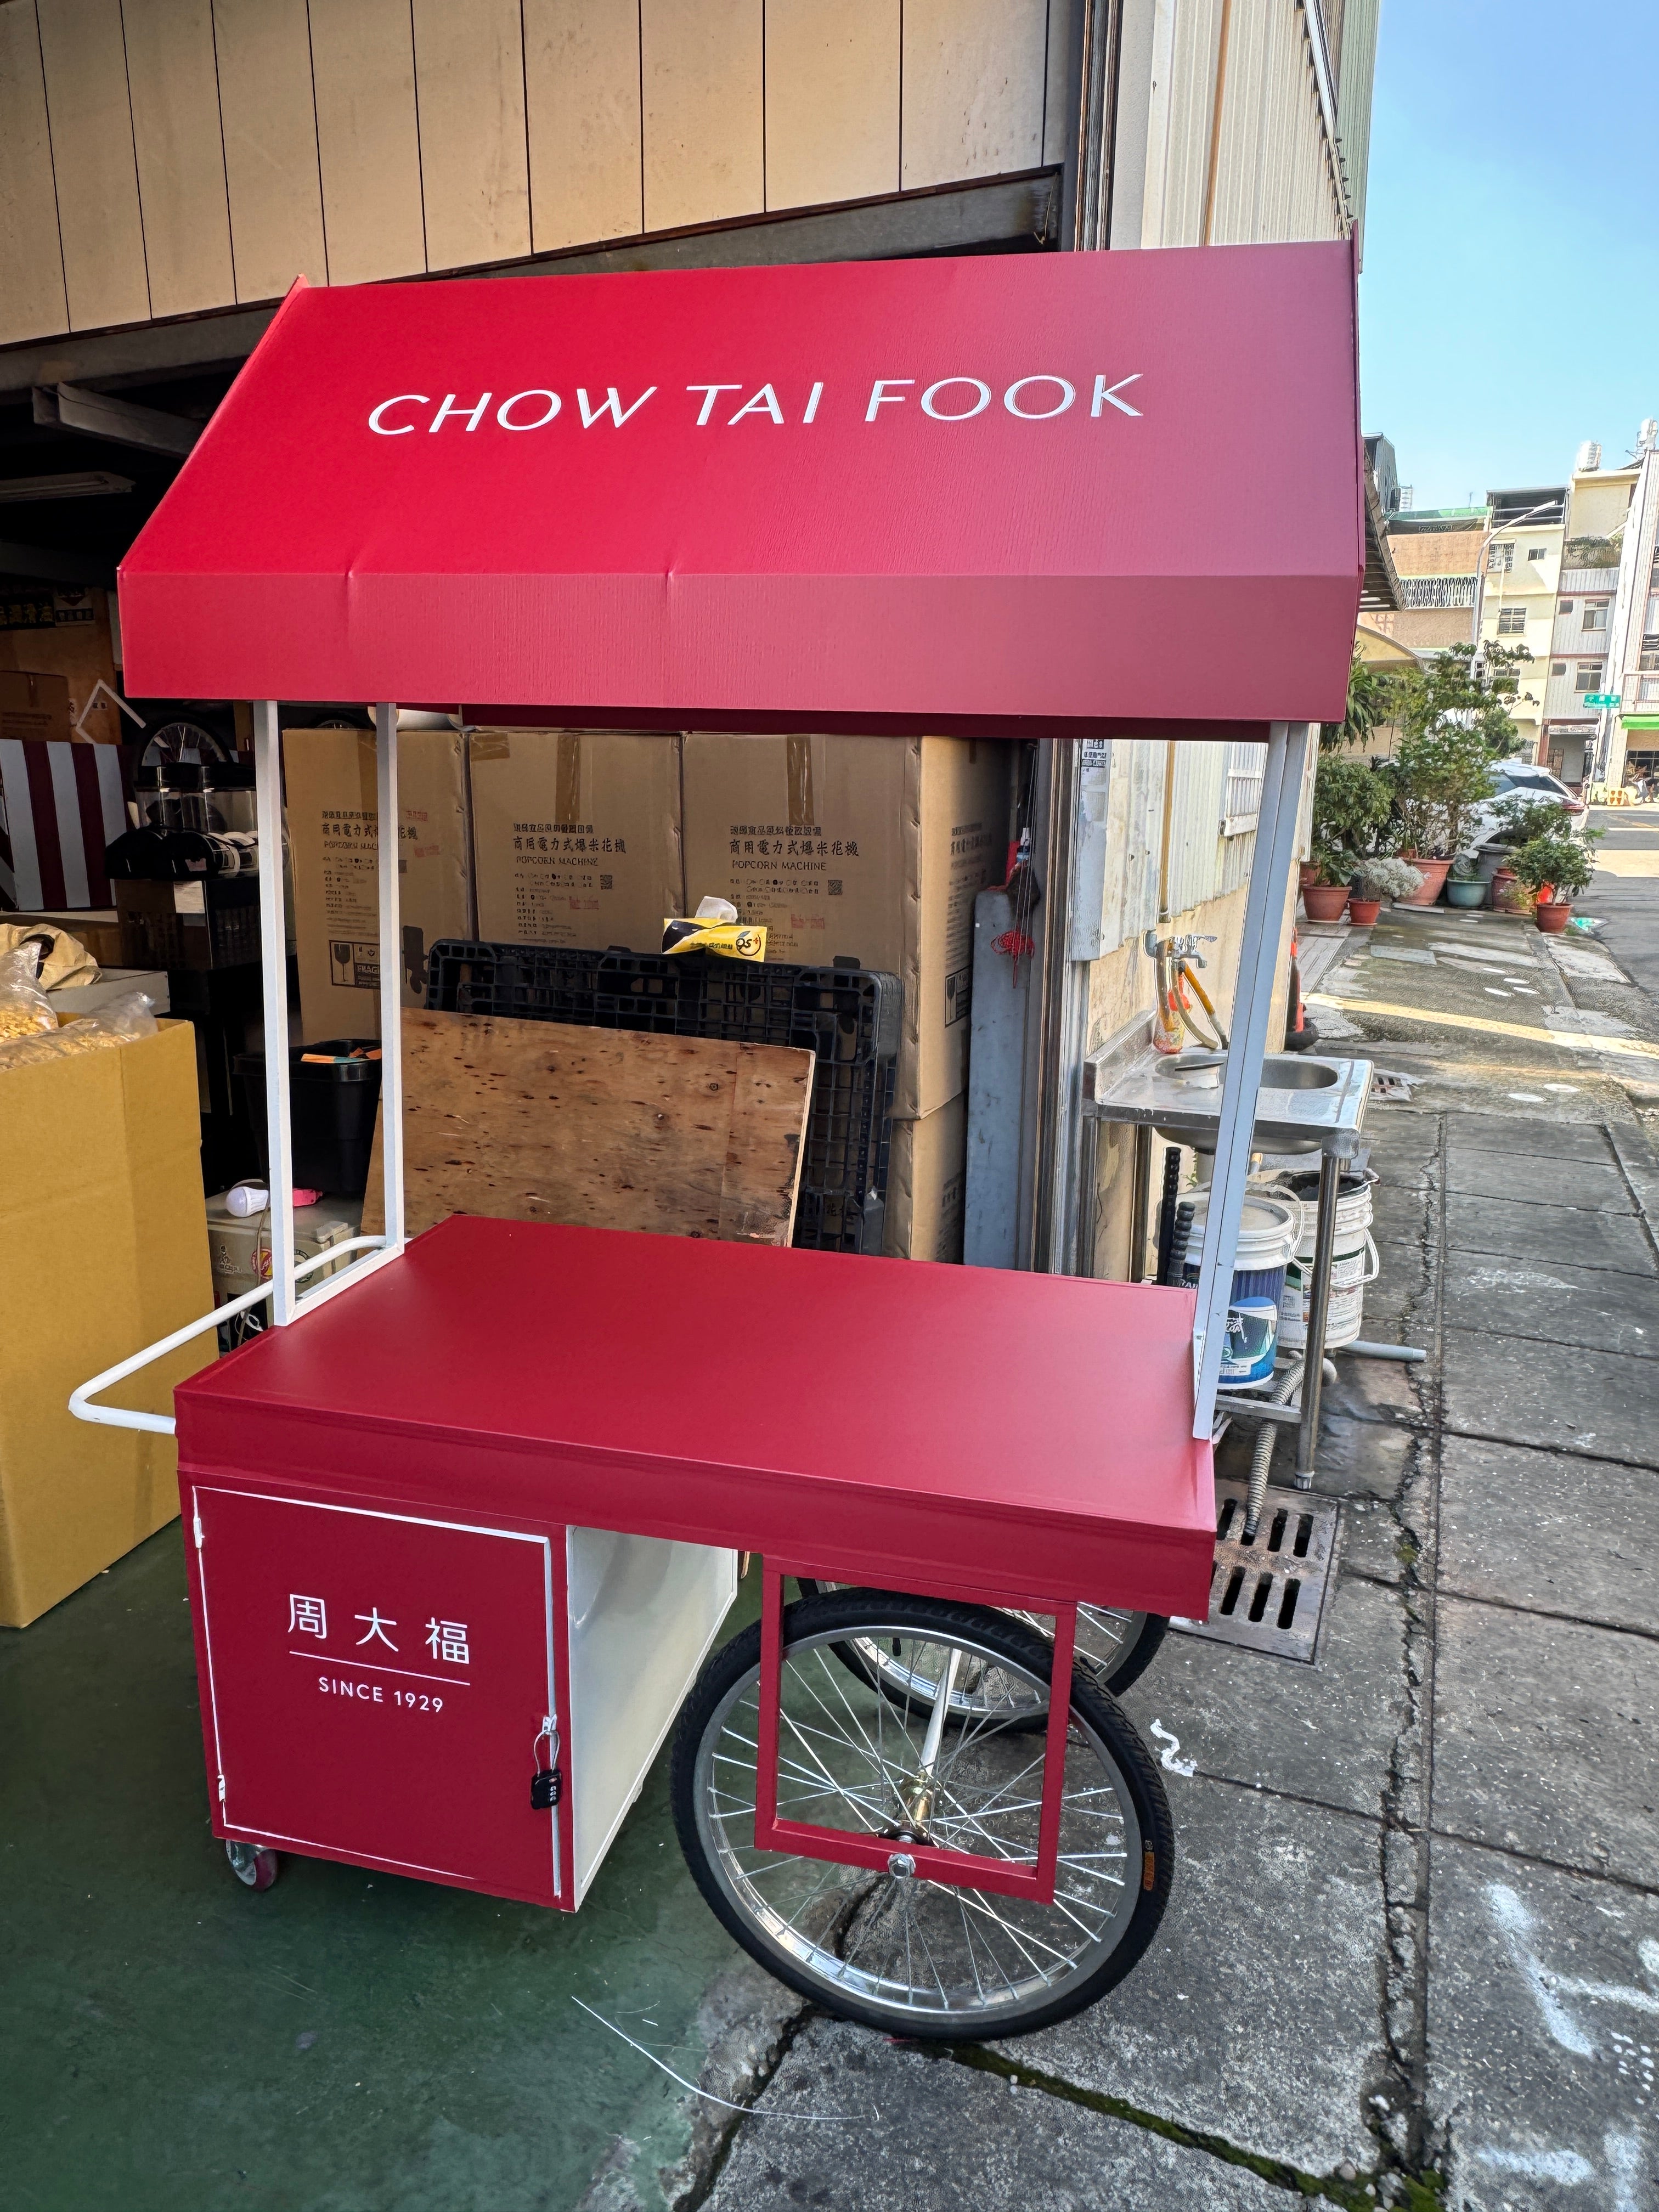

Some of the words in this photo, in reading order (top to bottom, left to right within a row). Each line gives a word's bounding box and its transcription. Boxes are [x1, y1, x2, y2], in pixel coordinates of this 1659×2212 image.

[368, 386, 658, 436] CHOW
[686, 382, 824, 426] TAI
[865, 374, 1144, 422] FOOK
[513, 836, 627, 854] 商用電力式爆米花機
[729, 839, 860, 856] 商用電力式爆米花機
[516, 856, 556, 865] POPCORN
[558, 857, 599, 866] MACHINE
[732, 860, 778, 870] POPCORN
[781, 861, 827, 871] MACHINE
[287, 1593, 470, 1664] 周大福
[318, 1677, 383, 1702] SINCE
[394, 1690, 443, 1713] 1929
